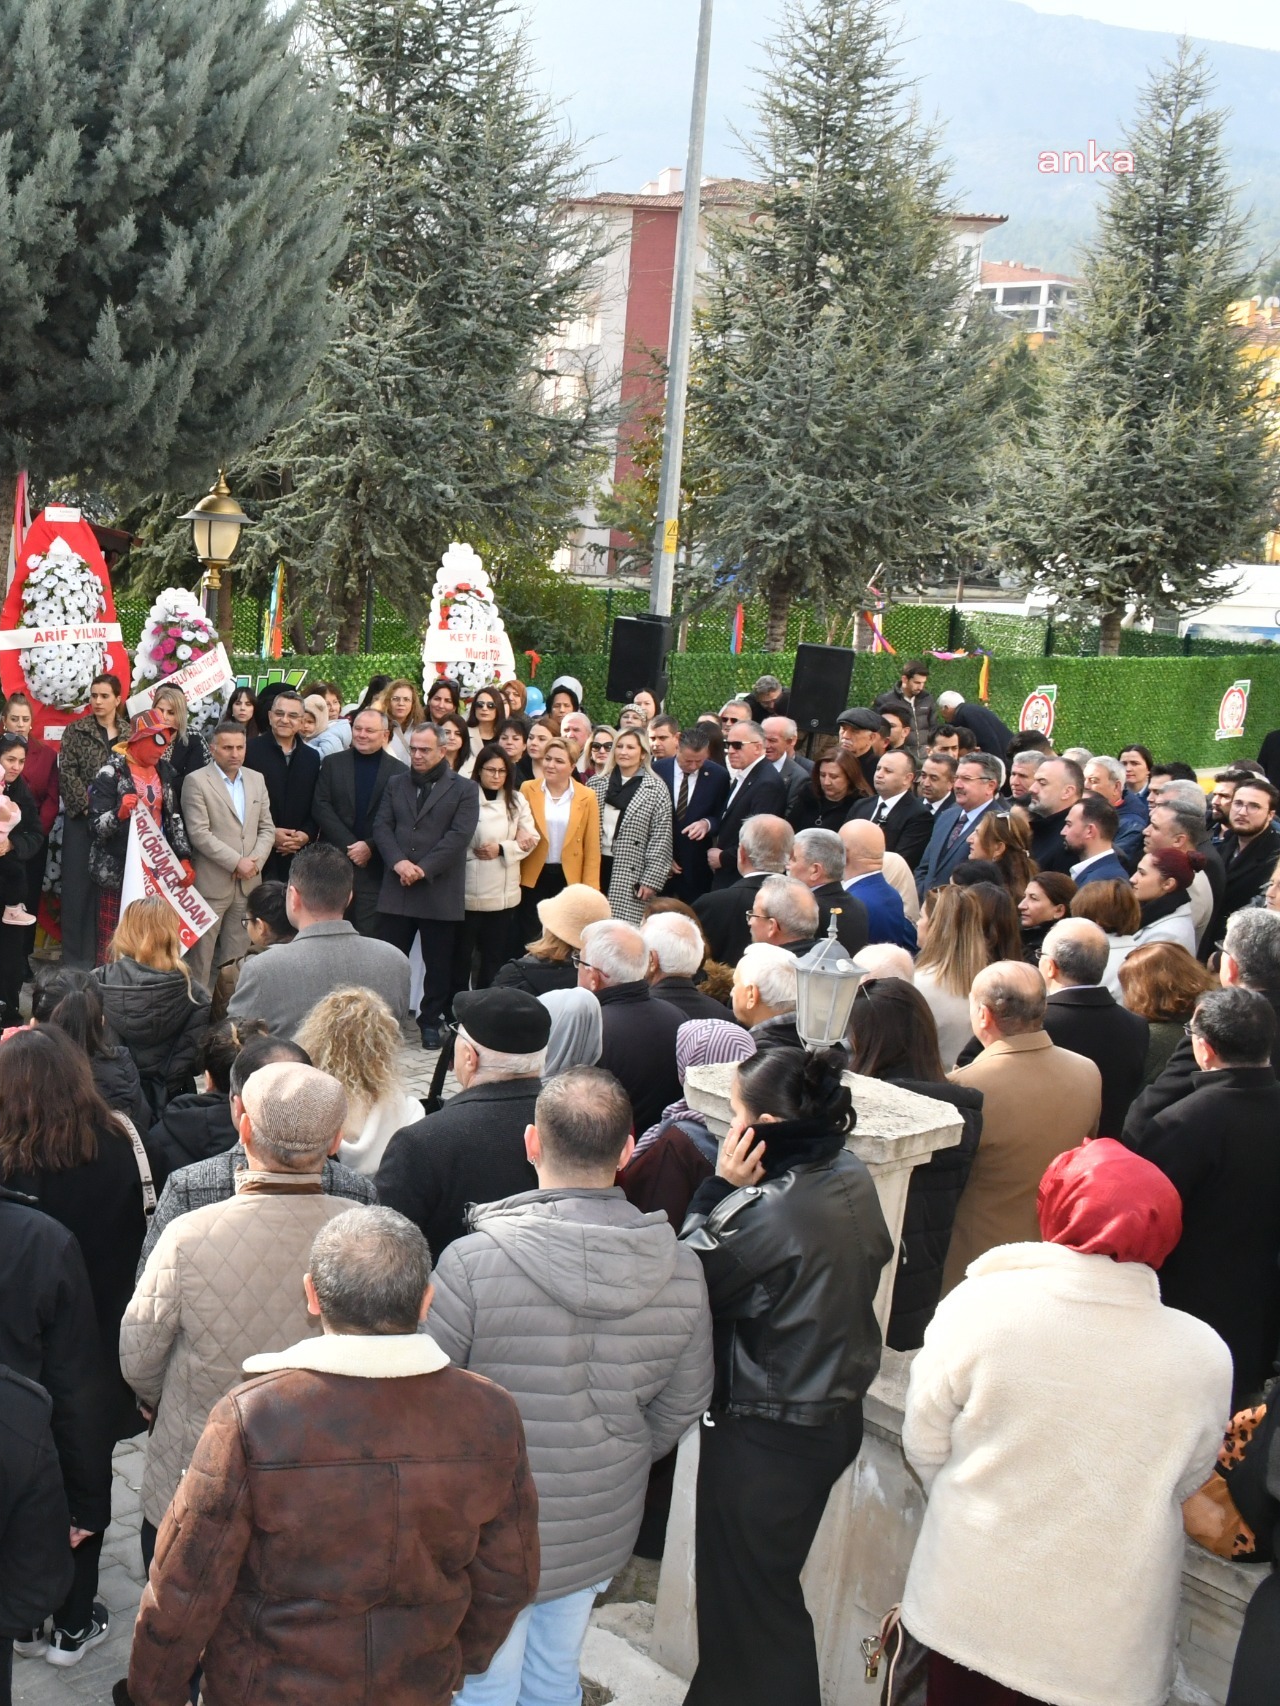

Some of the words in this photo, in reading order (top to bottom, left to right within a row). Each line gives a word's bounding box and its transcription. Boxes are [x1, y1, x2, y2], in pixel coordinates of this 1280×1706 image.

[34, 629, 69, 643] ARİF
[73, 627, 107, 640] YILMAZ
[449, 633, 477, 642] KEYF
[465, 647, 488, 660] Murat
[490, 649, 500, 661] TOP
[173, 886, 212, 930] ADAM
